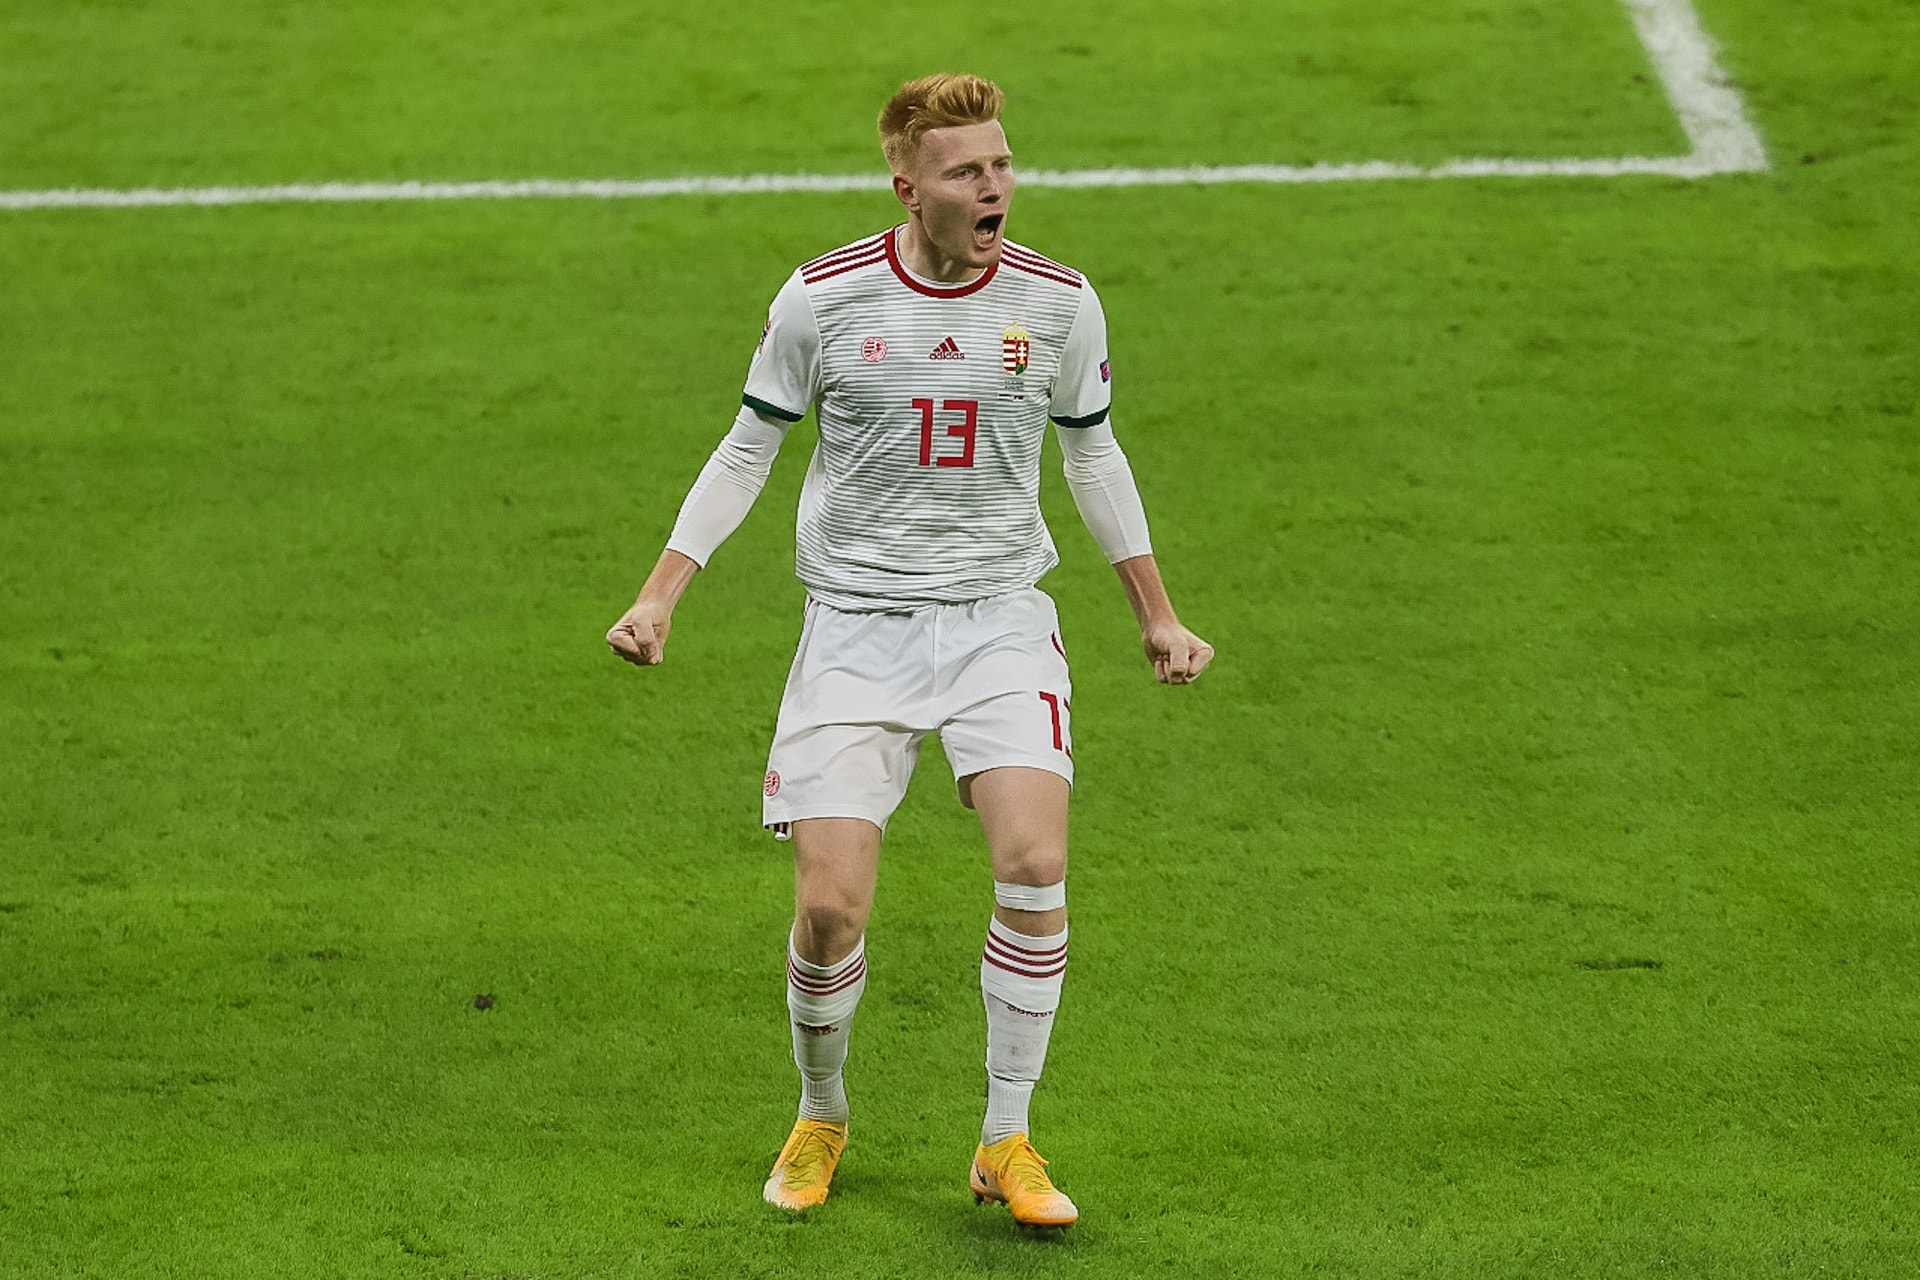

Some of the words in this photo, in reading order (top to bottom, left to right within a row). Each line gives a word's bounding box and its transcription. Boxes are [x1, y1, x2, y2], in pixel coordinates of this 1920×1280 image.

[929, 351, 966, 360] adidas
[911, 398, 979, 468] 13
[1038, 691, 1072, 758] 1
